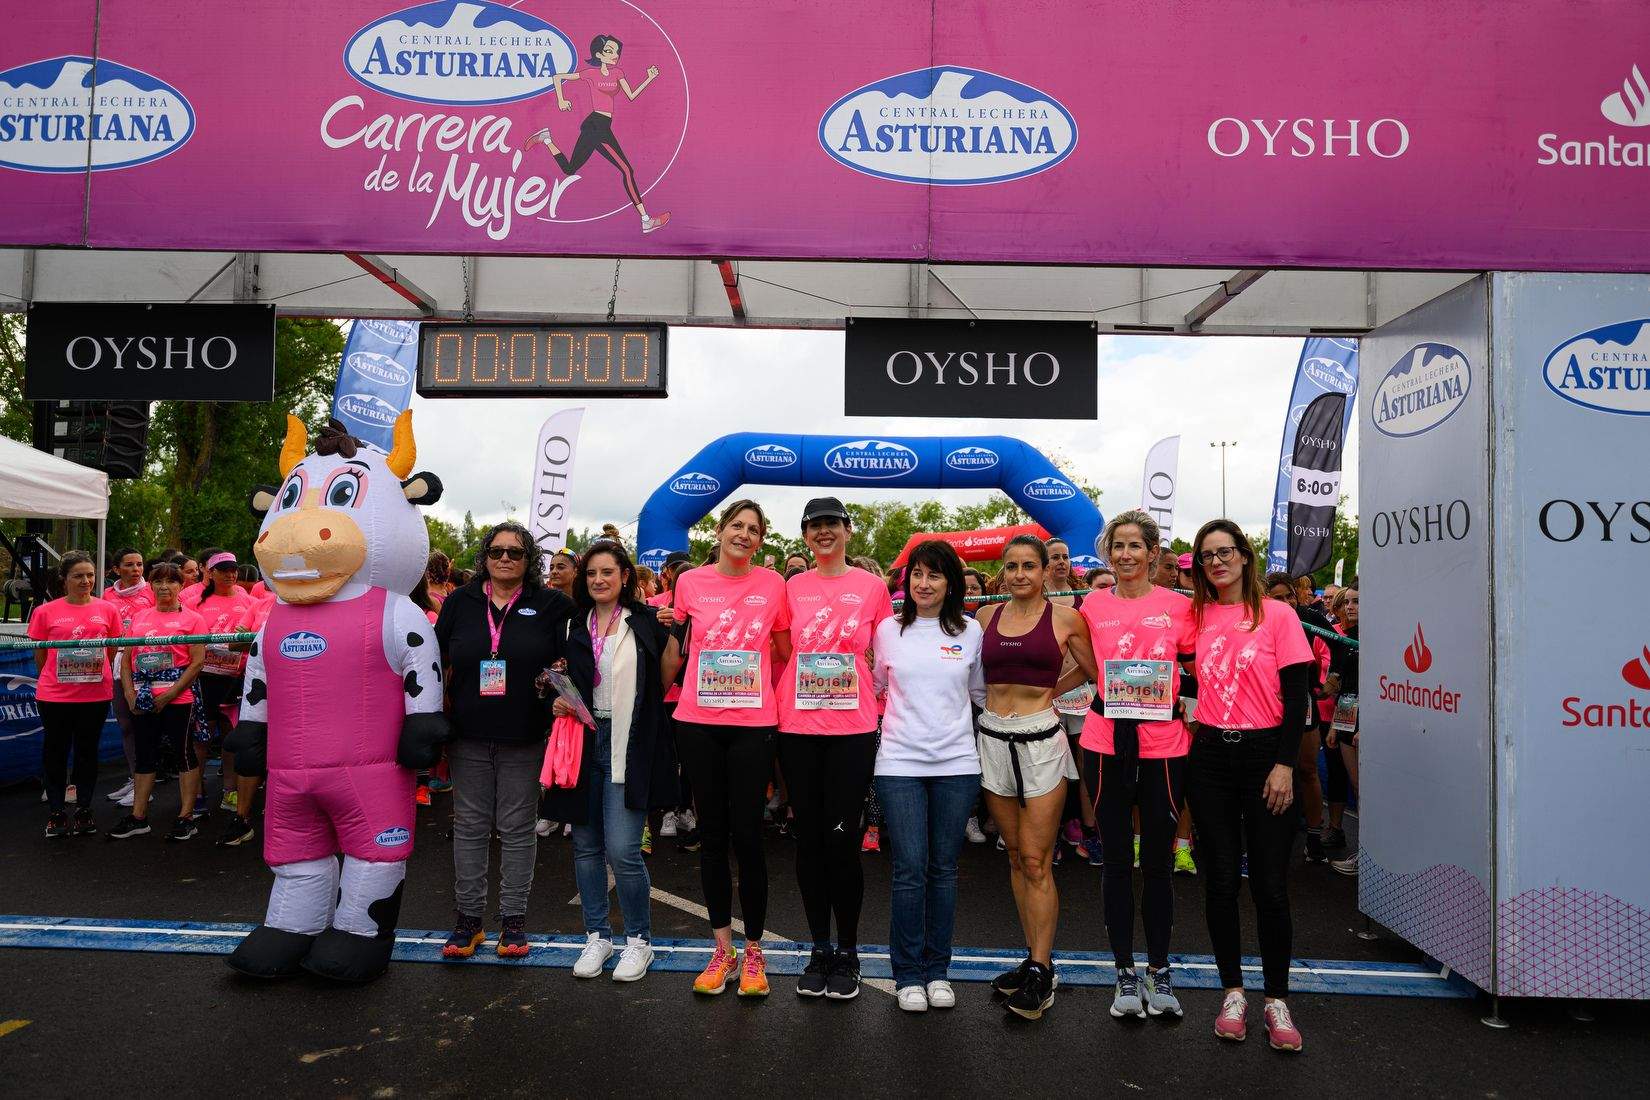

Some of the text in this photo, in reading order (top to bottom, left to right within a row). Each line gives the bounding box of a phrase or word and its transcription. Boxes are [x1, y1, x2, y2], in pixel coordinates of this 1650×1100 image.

[399, 35, 553, 47] CENTRAL LECHERA
[361, 36, 559, 79] ASTURIANA
[3, 96, 80, 108] CENTRAL
[879, 106, 1049, 119] CENTRAL LECHERA
[0, 112, 175, 142] STURIANA
[320, 95, 511, 154] Carrera
[838, 109, 1058, 154] ASTURIANA
[1207, 117, 1410, 159] OYSHO
[1537, 133, 1650, 167] Santa
[364, 149, 582, 241] de la Mujer
[65, 335, 238, 371] OYSHO
[352, 356, 406, 384] ASTURIANA
[886, 350, 1061, 387] OYSHO
[1306, 362, 1353, 393] ASTURIANA
[1392, 361, 1459, 394] CENTRAL LECHERA
[1378, 374, 1463, 424] ASTURIANA
[749, 451, 793, 463] ASTURIANA
[1301, 434, 1336, 451] OYSHO
[831, 451, 911, 469] ASTURIANA
[950, 454, 995, 465] ASTURIANA
[673, 481, 716, 491] ASTURIANA
[1027, 485, 1073, 496] ASTURIANA
[1372, 499, 1471, 548] OYSHO
[972, 535, 1006, 547] Santander
[282, 641, 323, 652] ASTURIANA
[719, 674, 742, 685] 016
[1126, 685, 1151, 696] 016
[1379, 674, 1461, 714] Santander
